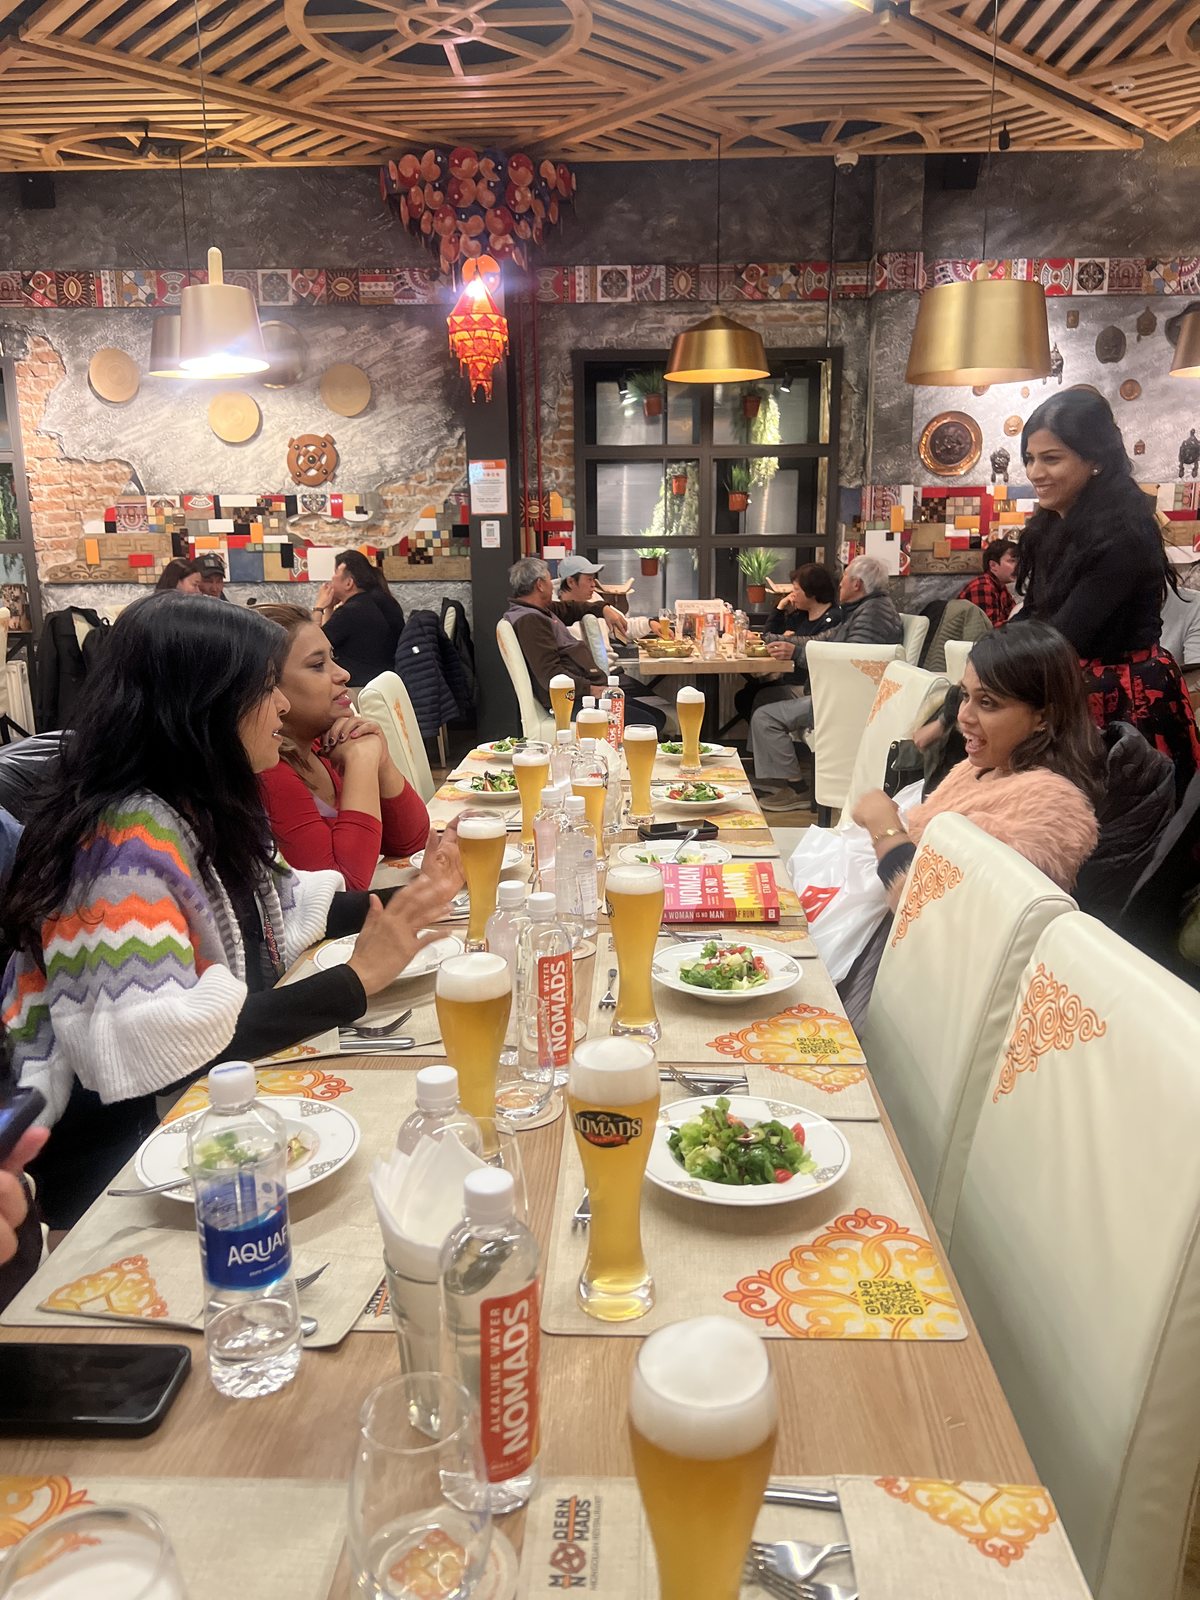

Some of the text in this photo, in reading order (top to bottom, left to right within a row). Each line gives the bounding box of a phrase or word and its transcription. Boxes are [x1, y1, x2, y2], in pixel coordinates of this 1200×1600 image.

[678, 867, 702, 905] WOMAN
[705, 877, 719, 887] NO
[722, 873, 747, 898] MAN
[668, 910, 694, 919] WOMAN
[709, 910, 725, 919] MAN
[742, 910, 755, 918] RUM
[551, 960, 567, 1052] NOMADS
[490, 1307, 501, 1434] ALKALINE WATER
[502, 1298, 529, 1456] NOMADS
